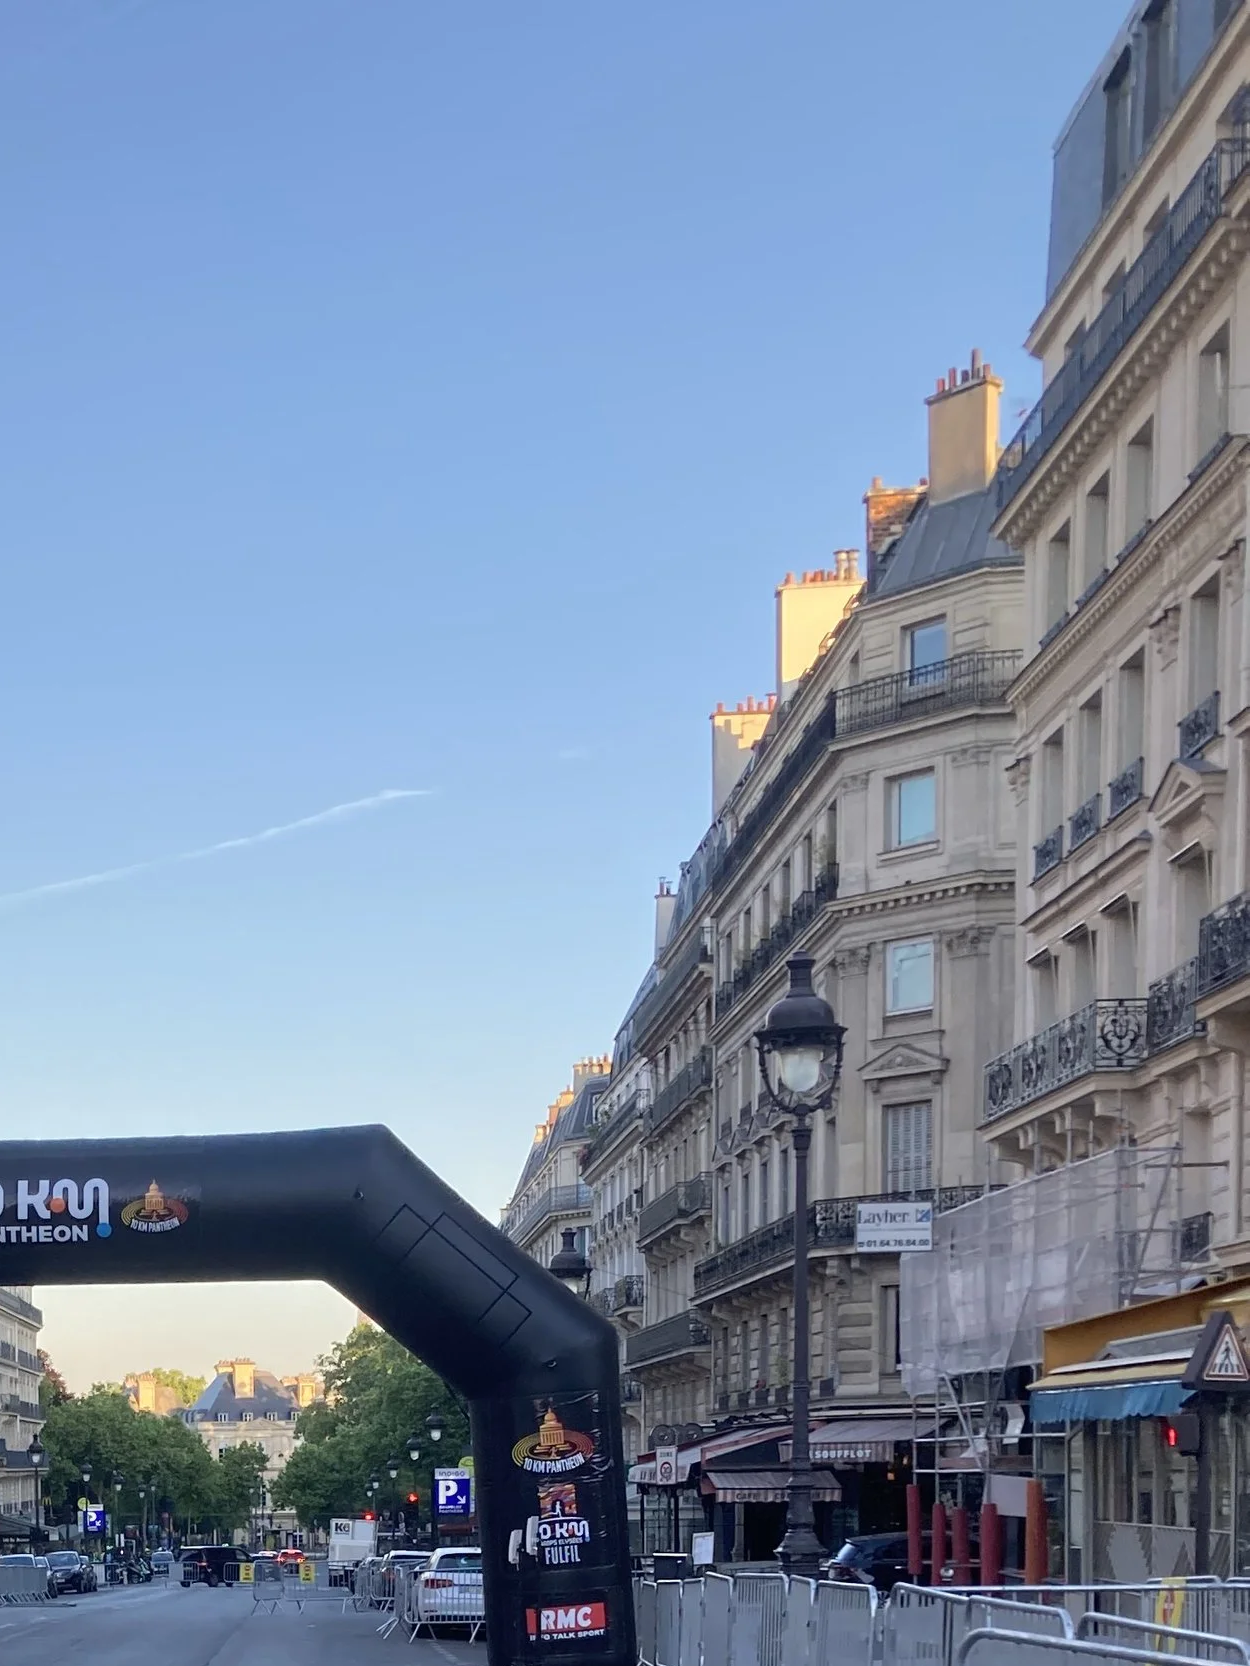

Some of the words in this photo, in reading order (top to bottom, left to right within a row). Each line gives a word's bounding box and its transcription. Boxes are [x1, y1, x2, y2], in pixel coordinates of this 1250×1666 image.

[17, 1178, 110, 1225] KM
[148, 1217, 181, 1233] PANTHEON
[523, 1457, 532, 1471] 10
[532, 1459, 545, 1474] KM
[545, 1452, 586, 1474] PANTHEON
[814, 1449, 872, 1459] SOUFFLOT
[439, 1480, 458, 1505] P
[87, 1512, 97, 1526] P
[538, 1524, 552, 1540] 0
[555, 1520, 590, 1542] KM
[545, 1545, 581, 1565] FULFIL
[540, 1606, 592, 1631] RMC
[552, 1631, 576, 1640] TALK
[578, 1629, 605, 1638] SPORT
